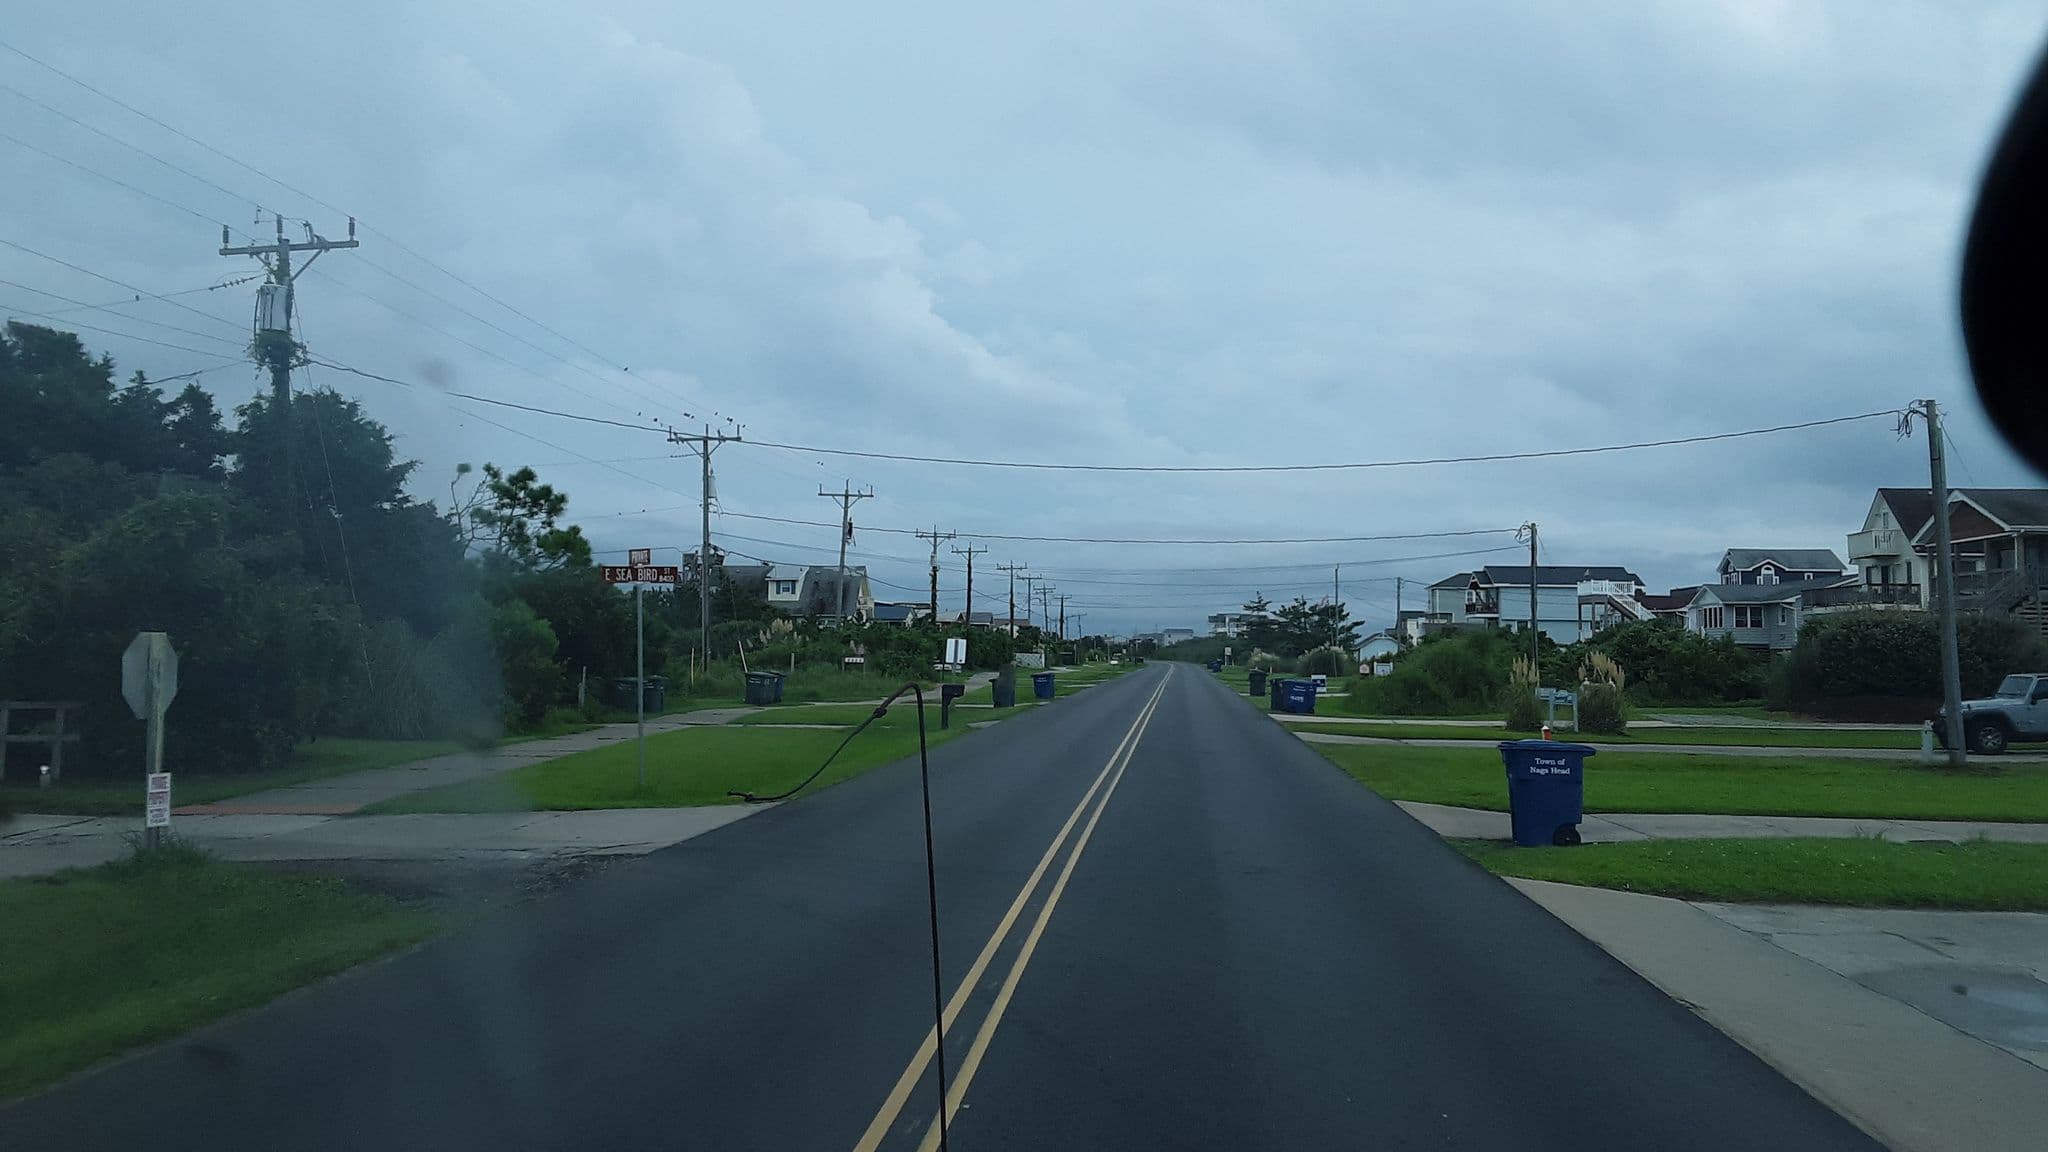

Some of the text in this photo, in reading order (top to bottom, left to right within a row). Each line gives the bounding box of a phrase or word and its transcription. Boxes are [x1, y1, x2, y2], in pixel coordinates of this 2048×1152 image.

[605, 568, 610, 581] E
[616, 568, 633, 581] SEA
[638, 568, 658, 581] BIRD
[1535, 757, 1556, 765] Town
[1530, 766, 1570, 775] Nags Head
